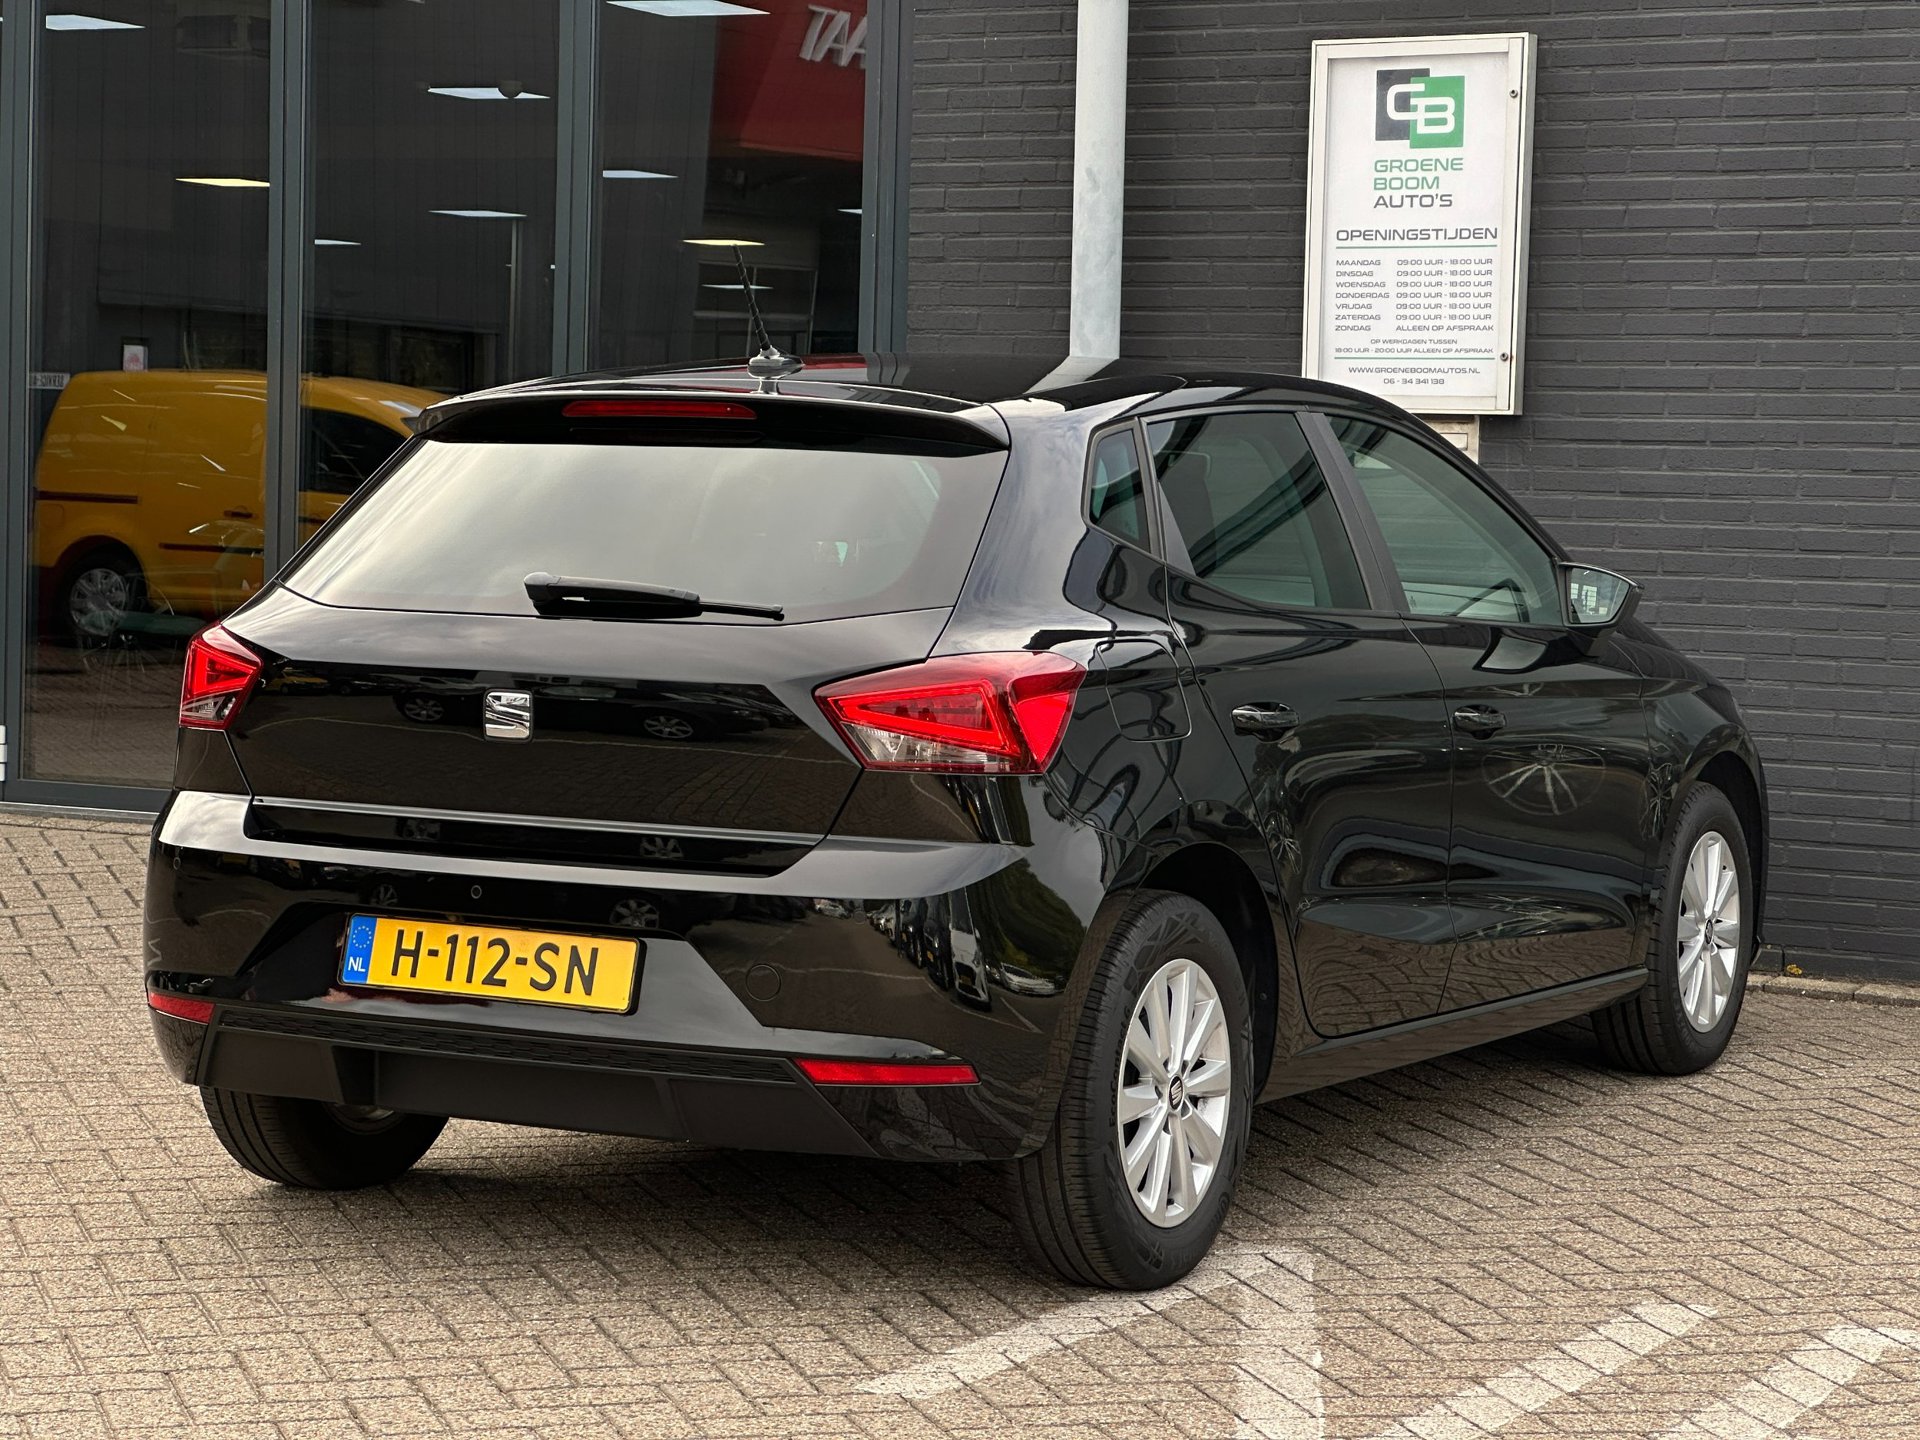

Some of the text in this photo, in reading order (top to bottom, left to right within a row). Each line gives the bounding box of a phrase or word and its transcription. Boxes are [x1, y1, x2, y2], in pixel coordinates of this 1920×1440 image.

[1374, 158, 1464, 173] GROENE
[1374, 176, 1440, 190] BOOM
[1374, 194, 1453, 208] AUTO'S
[1336, 227, 1498, 242] OPENINGSTIJDEN
[348, 956, 366, 973] NL
[391, 929, 599, 996] H-112-SN
